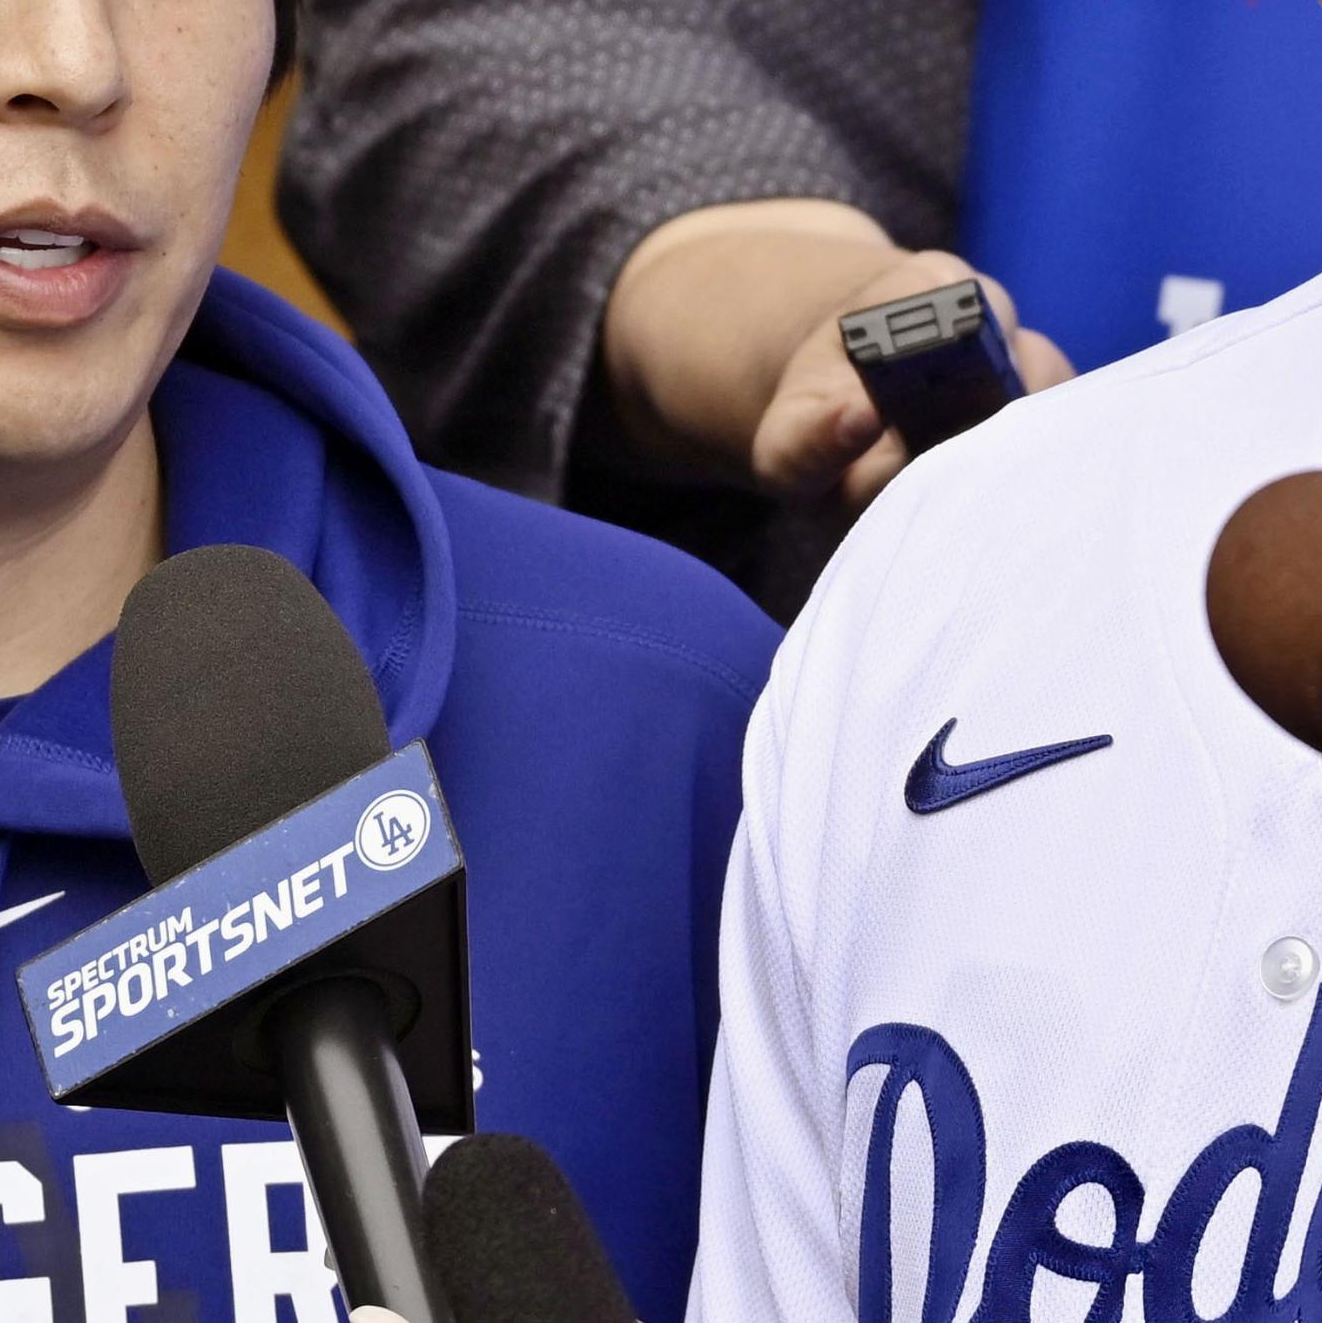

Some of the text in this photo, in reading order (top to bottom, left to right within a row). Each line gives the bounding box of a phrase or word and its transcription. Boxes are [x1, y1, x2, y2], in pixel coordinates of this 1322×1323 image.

[373, 812, 412, 857] LA
[47, 906, 193, 1011] SPECTRUM
[50, 842, 356, 1059] SPORTSNET
